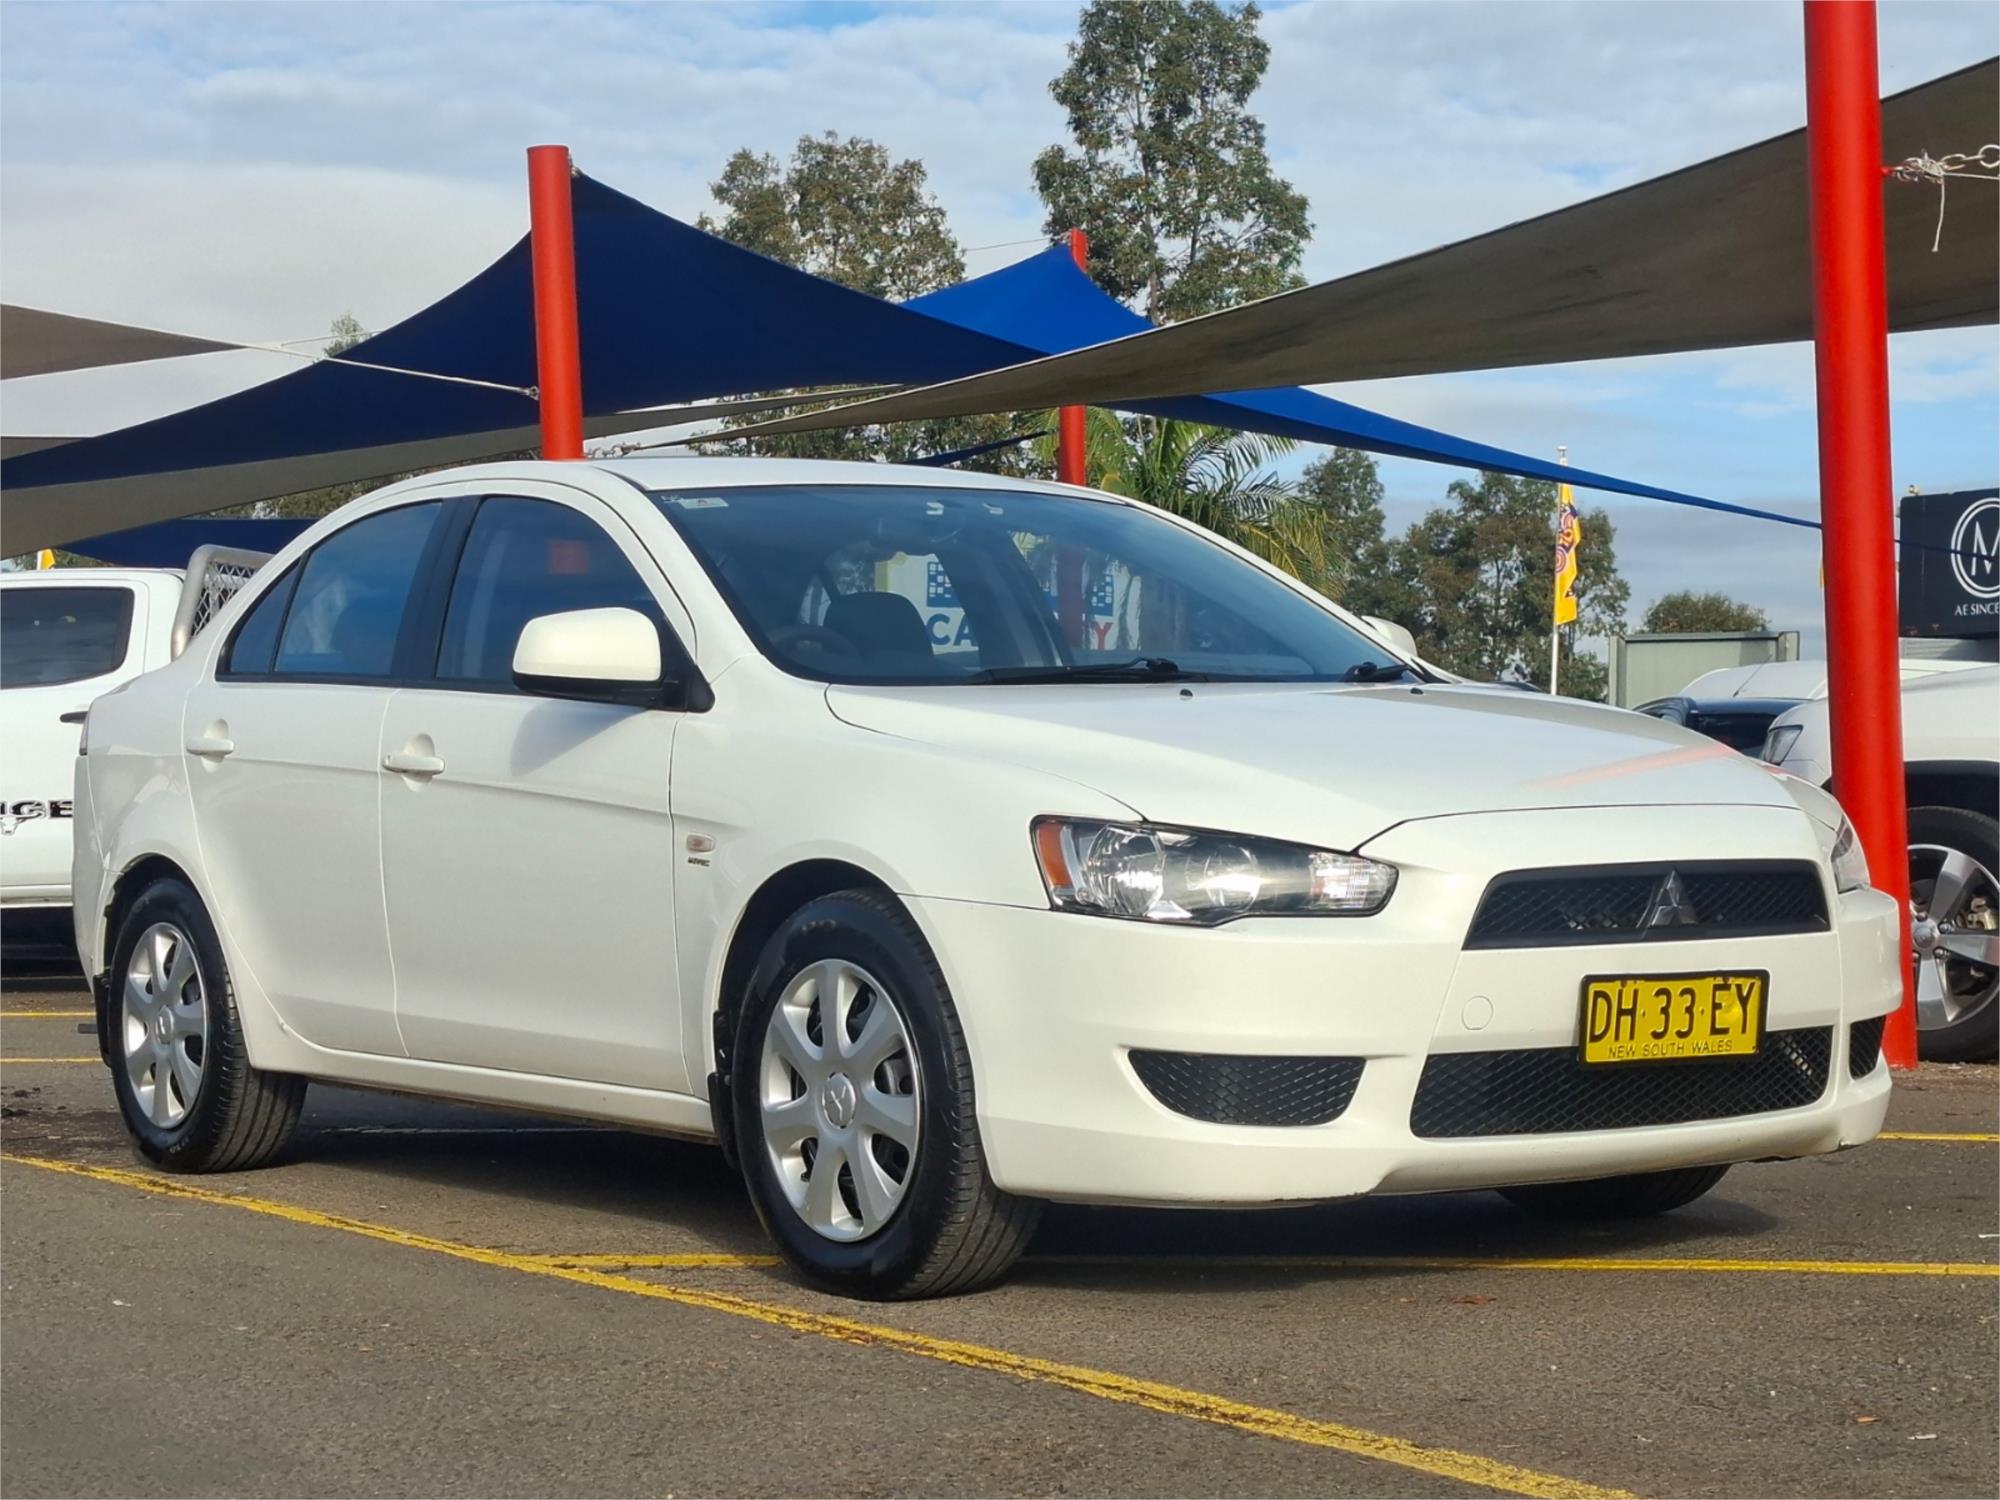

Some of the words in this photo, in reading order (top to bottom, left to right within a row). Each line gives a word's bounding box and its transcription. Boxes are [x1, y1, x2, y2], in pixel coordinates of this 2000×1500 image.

[1970, 602, 1999, 615] SINCE
[1589, 988, 1638, 1043] DH
[1650, 987, 1696, 1040] 33
[1710, 982, 1756, 1036] EY
[1608, 1046, 1636, 1059] NEW
[1642, 1042, 1685, 1057] SOUTH
[1692, 1039, 1733, 1054] WALES
